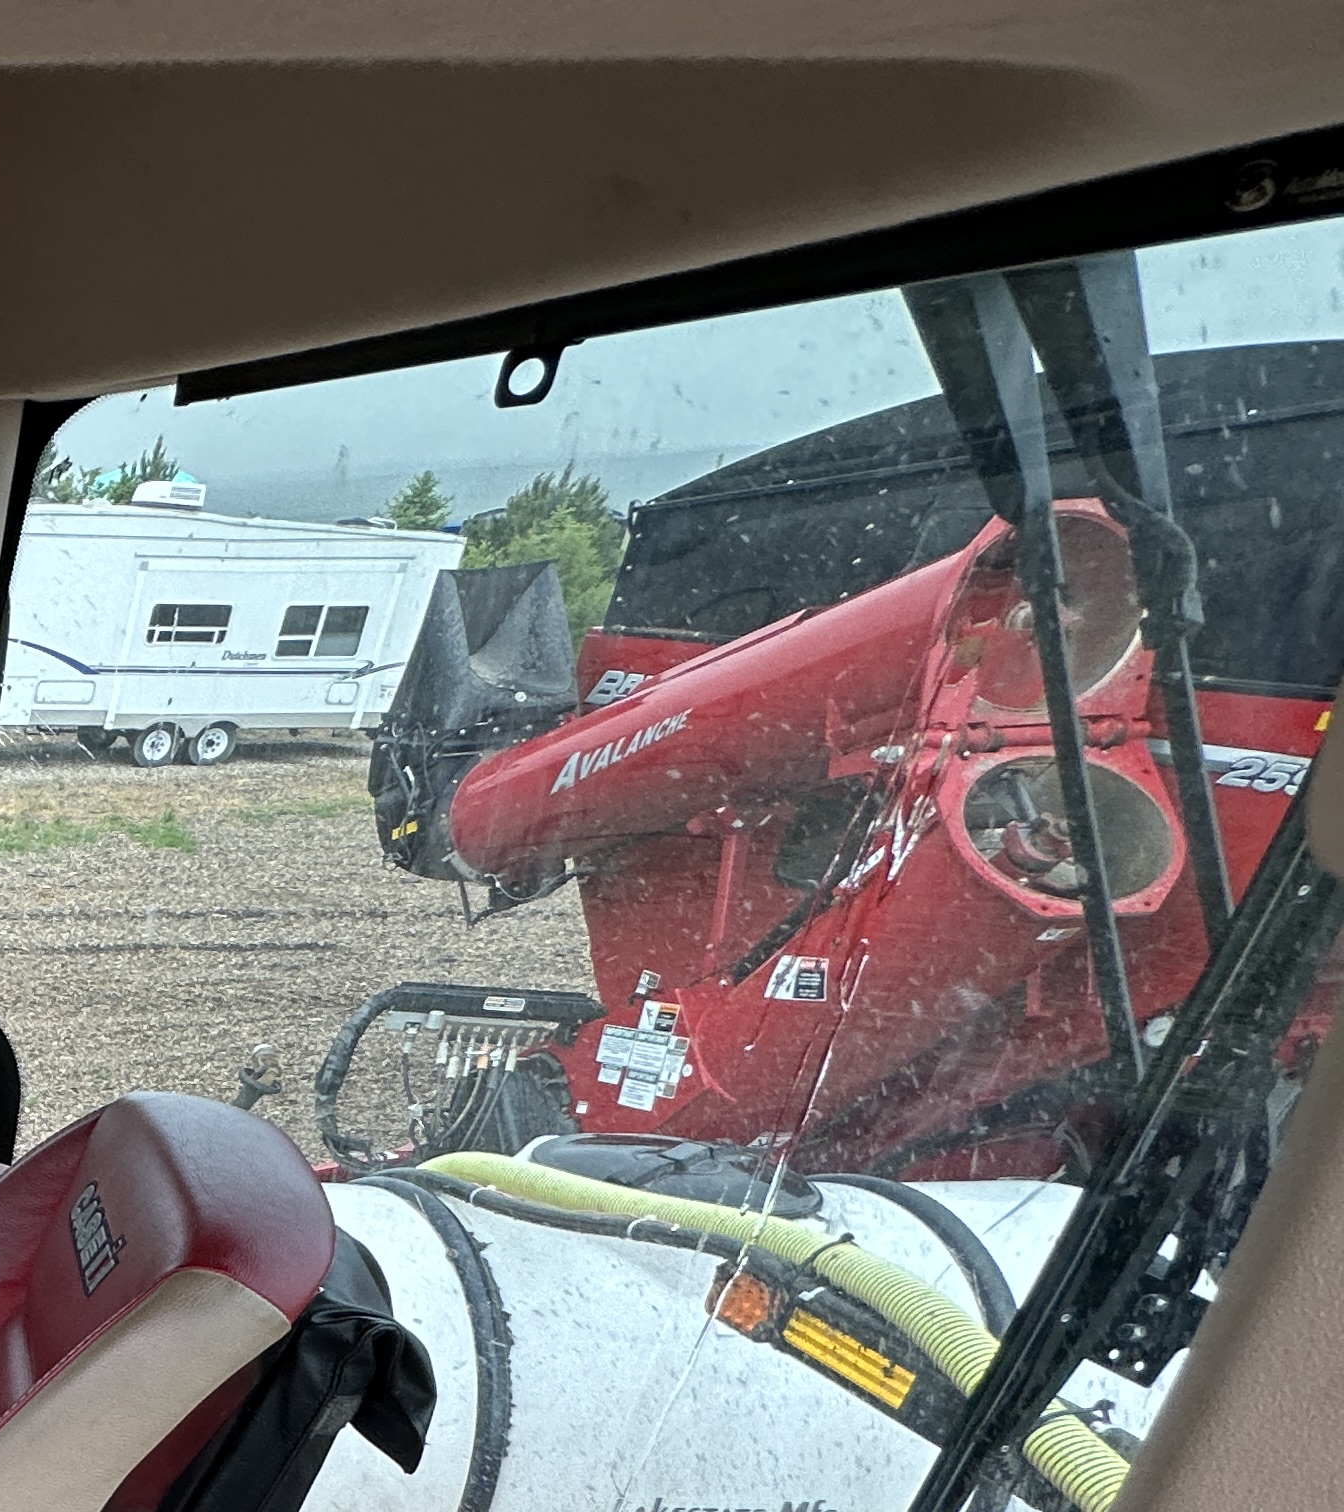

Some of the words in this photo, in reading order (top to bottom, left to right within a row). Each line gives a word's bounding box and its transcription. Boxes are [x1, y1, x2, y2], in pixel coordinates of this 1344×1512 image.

[583, 669, 654, 706] BR
[549, 707, 693, 796] AVALANCHE
[70, 1181, 108, 1270] CASE
